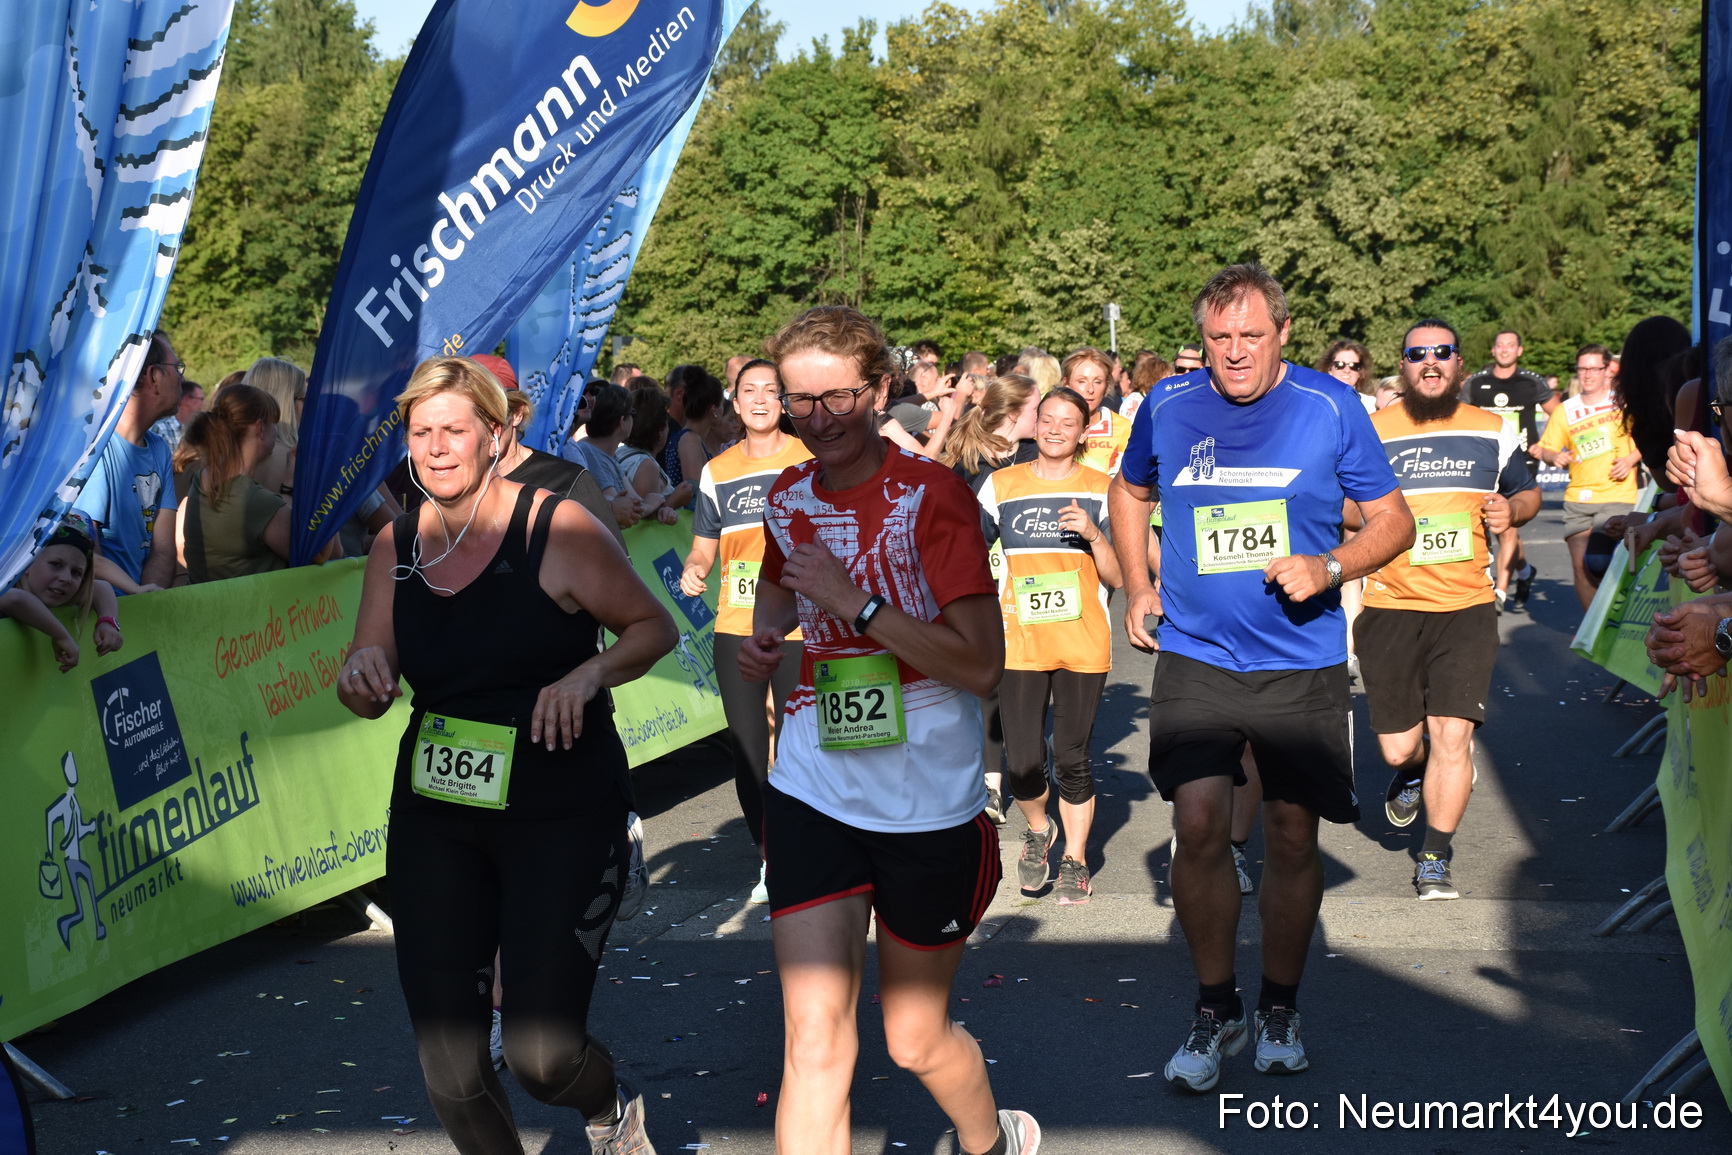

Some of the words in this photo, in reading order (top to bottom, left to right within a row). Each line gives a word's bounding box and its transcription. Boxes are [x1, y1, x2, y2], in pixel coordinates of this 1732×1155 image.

[514, 140, 577, 215] Druck
[575, 91, 618, 144] und
[616, 6, 696, 98] Medien
[354, 55, 602, 348] Frischmann
[1173, 381, 1190, 390] JAKO
[1570, 421, 1595, 436] MAX
[1088, 440, 1113, 449] ÖGL
[1580, 437, 1606, 453] 1337
[308, 403, 403, 532] www.frischma
[1219, 469, 1284, 477] Schornsteintechnik
[1402, 457, 1476, 473] Fischer
[1409, 471, 1471, 479] AUTOMOBILE
[741, 506, 764, 516] AUTO
[1207, 525, 1277, 554] 1784
[1422, 531, 1459, 550] 567
[1213, 553, 1244, 562] Kosmehl
[1029, 590, 1066, 610] 573
[287, 594, 344, 642] Firmen
[258, 662, 318, 719] laufen
[841, 679, 861, 688] 2018
[820, 688, 887, 725] 1852
[114, 699, 162, 737] Fischer
[124, 721, 164, 749] AUTOMOBILE
[827, 726, 842, 734] Meier
[843, 724, 874, 733] Andrea
[837, 731, 891, 741] Neumarkt-Parsberg
[423, 743, 495, 784] 1364
[428, 783, 446, 792] Michael
[446, 787, 459, 795] Klein
[460, 790, 478, 798] GmbH
[431, 775, 447, 786] Nutz
[448, 778, 477, 791] Brigitte
[96, 731, 260, 890] firmenlauf
[230, 808, 391, 908] www.firmenlauf-oberp
[110, 857, 184, 924] neumarkt
